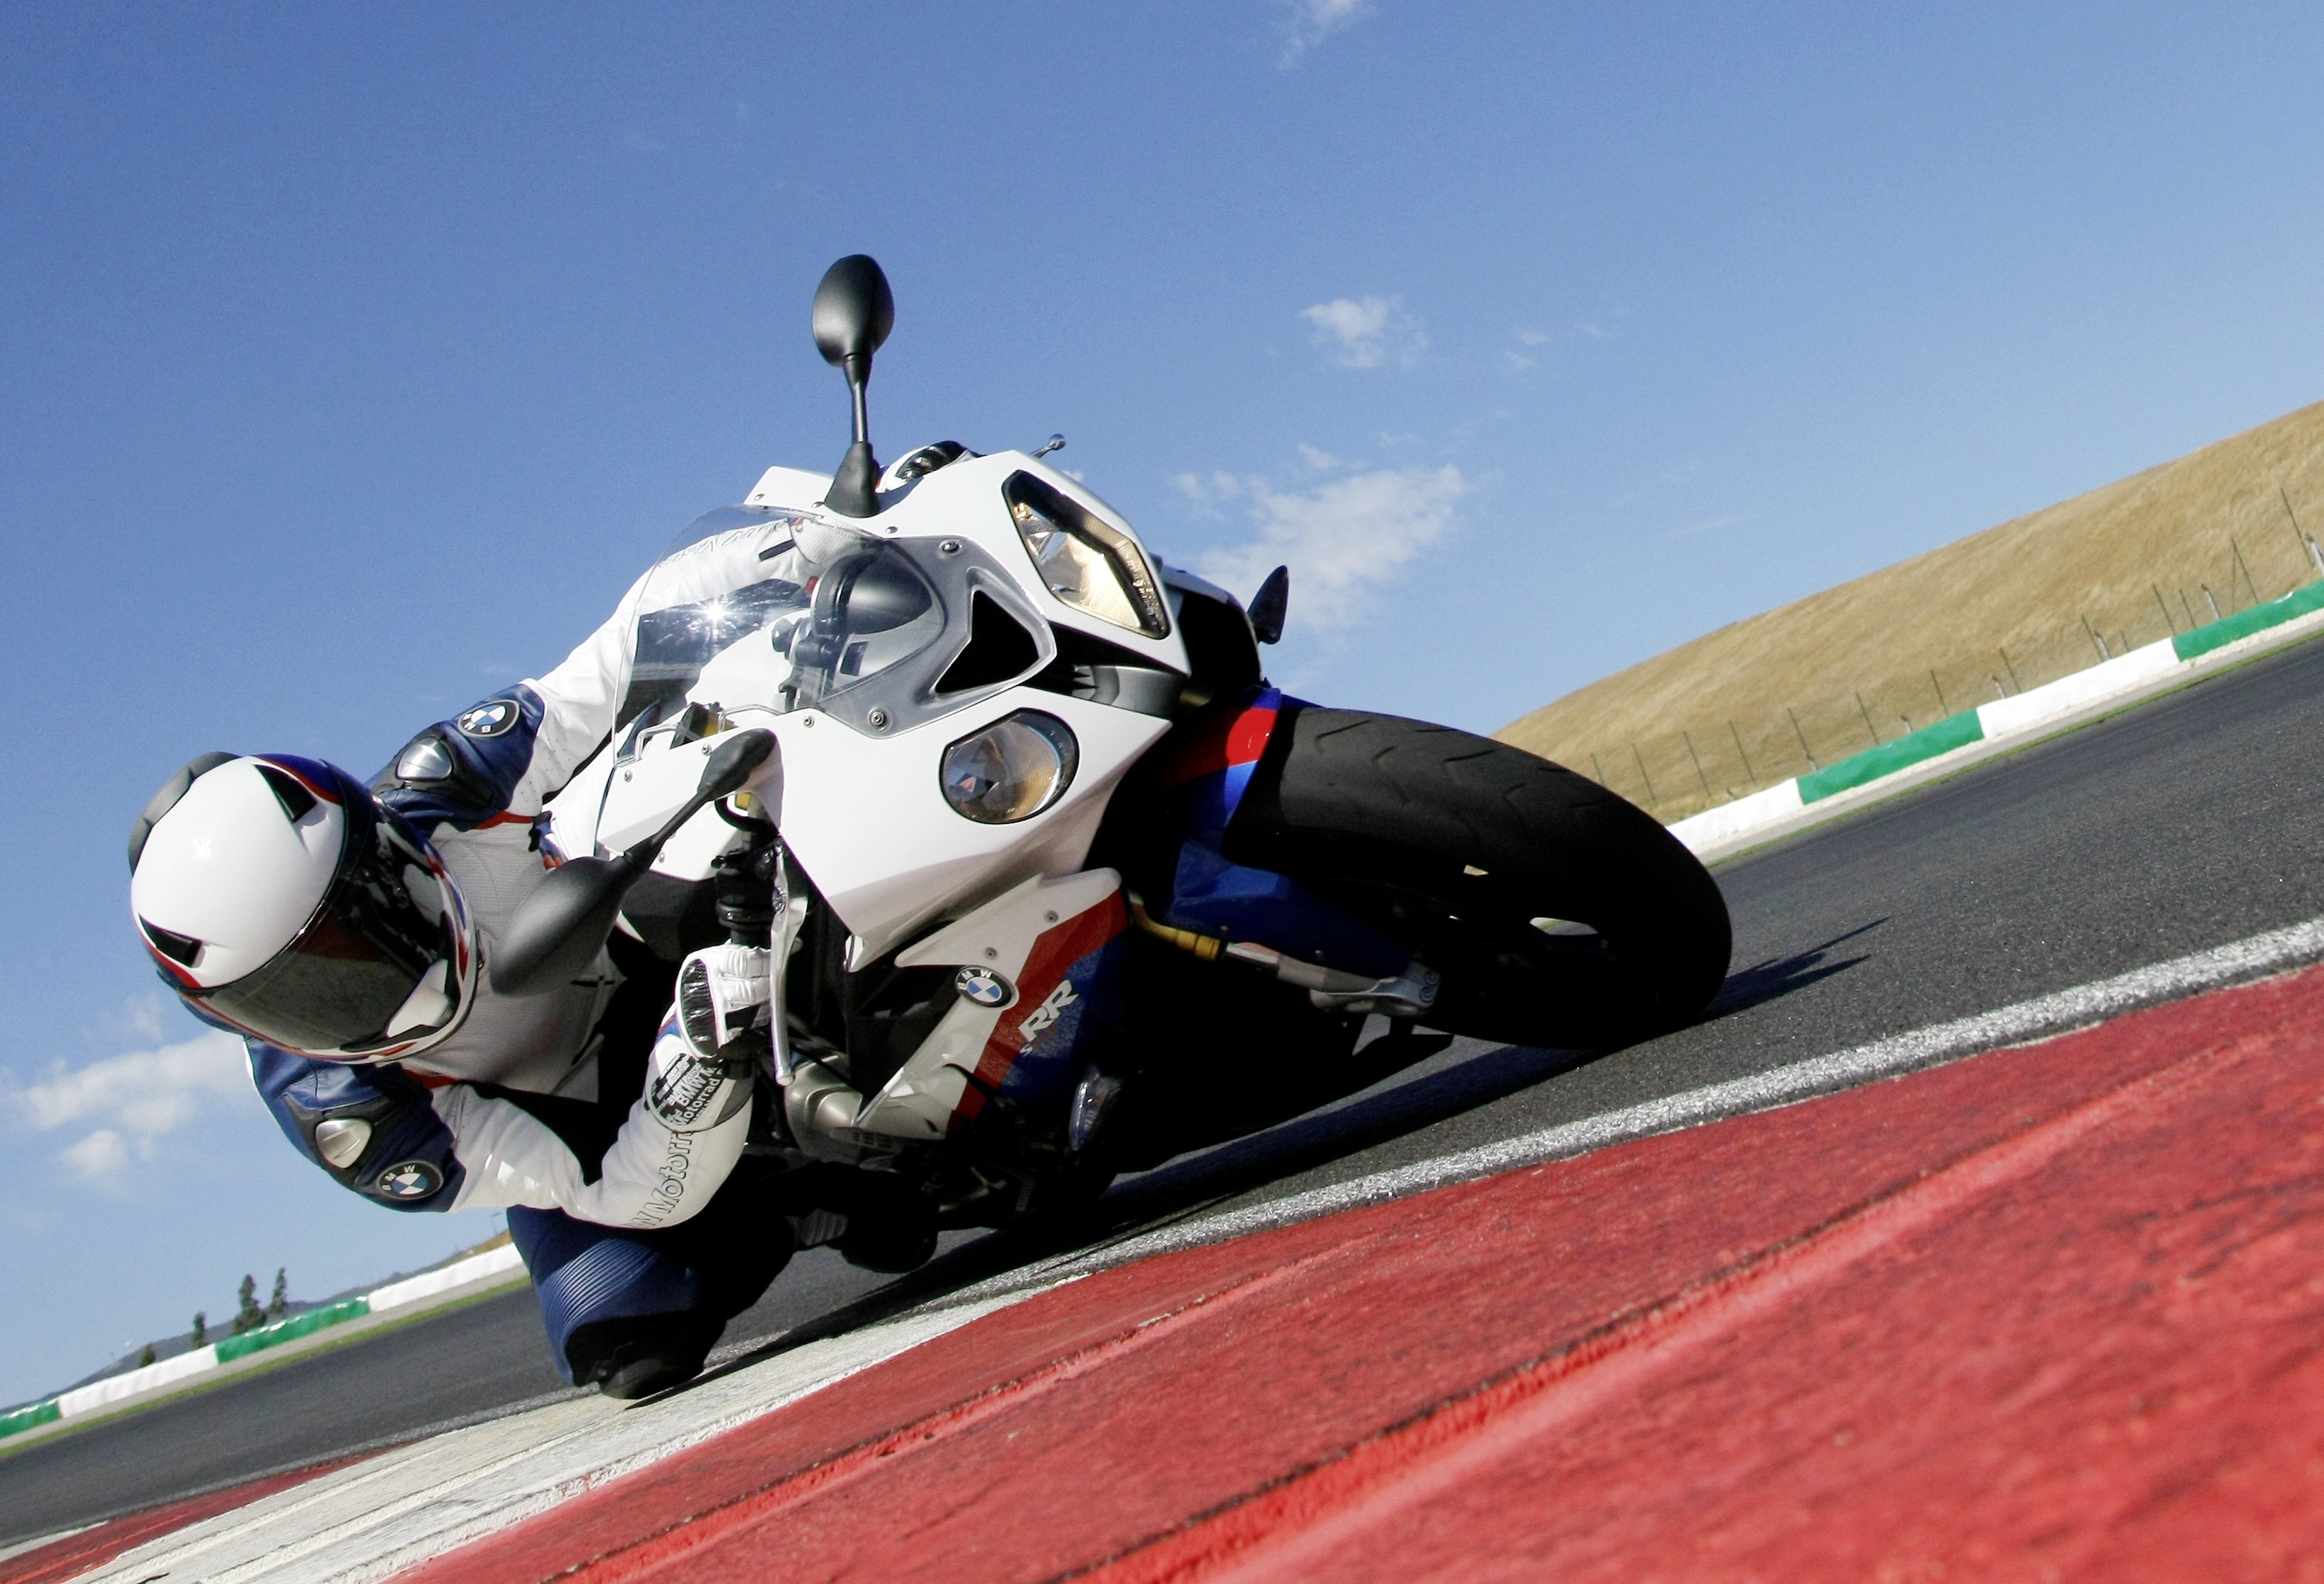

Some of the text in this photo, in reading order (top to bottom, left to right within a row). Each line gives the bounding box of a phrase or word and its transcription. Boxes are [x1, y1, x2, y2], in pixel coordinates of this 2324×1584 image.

[957, 970, 993, 990] BMW
[1018, 979, 1079, 1042] RR
[671, 1077, 721, 1125] Motorrad
[382, 1165, 415, 1190] BMW
